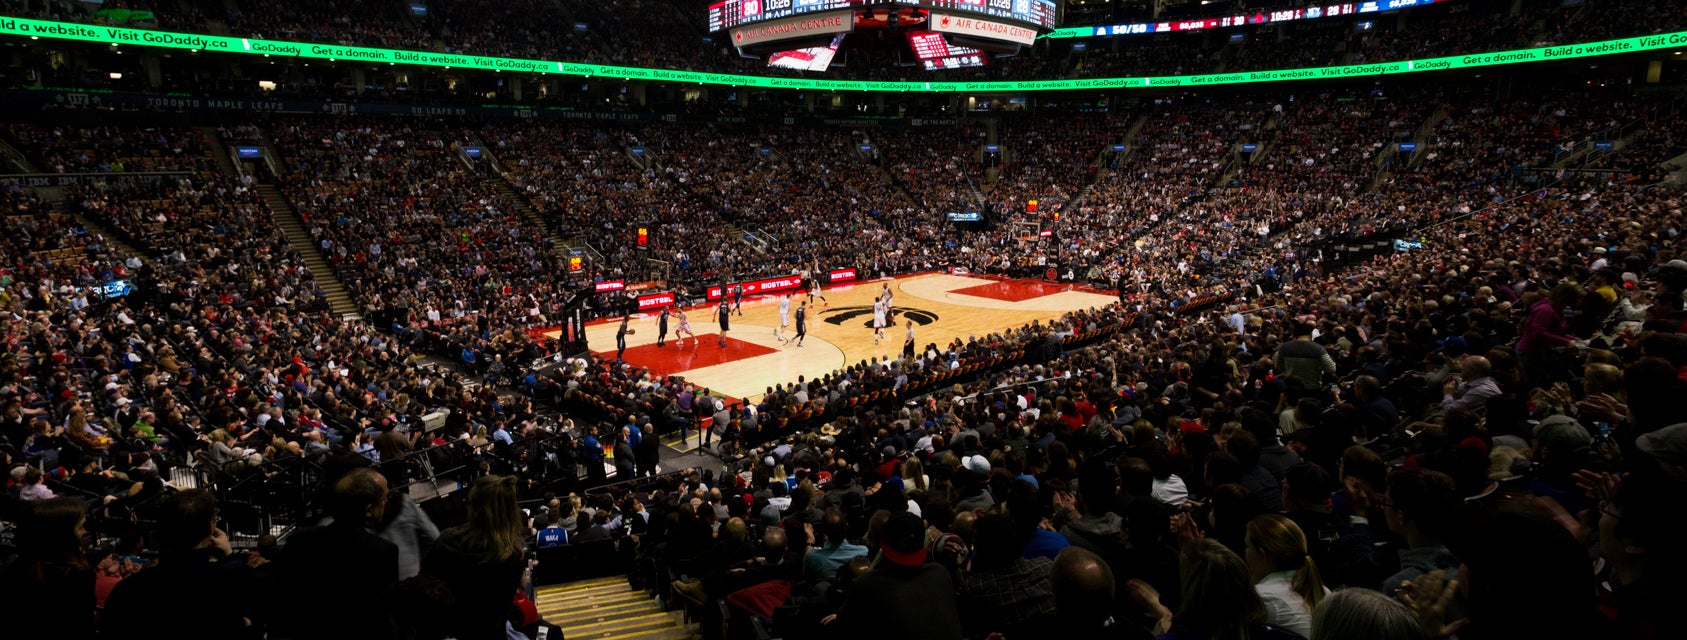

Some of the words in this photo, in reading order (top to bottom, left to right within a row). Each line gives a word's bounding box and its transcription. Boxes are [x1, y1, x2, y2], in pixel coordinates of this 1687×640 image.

[1270, 10, 1294, 22] 10:26
[1327, 6, 1340, 16] 28
[1234, 16, 1244, 26] 30
[746, 30, 758, 39] AIR
[762, 24, 797, 36] CANADA
[801, 17, 841, 30] CENTRE
[956, 18, 972, 30] AIR
[976, 21, 1008, 34] CANADA
[1010, 27, 1034, 40] CENTRE
[1112, 24, 1146, 35] 50/50
[34, 25, 101, 37] website.
[107, 29, 140, 40] Visit
[143, 33, 228, 48] GoDaddy.ca
[252, 43, 301, 54] GoDaddy
[312, 46, 333, 55] Get
[346, 49, 388, 58] domain.
[394, 52, 420, 61] Build
[430, 56, 470, 64] website.
[474, 58, 494, 66] Visit
[496, 60, 548, 70] GoDaddy.ca
[1414, 61, 1452, 69] GoDaddy
[1494, 52, 1536, 61] domain.
[1544, 47, 1572, 56] Build
[1585, 42, 1632, 53] website.
[1640, 37, 1666, 47] Visit
[564, 66, 594, 74] GoDaddy
[1343, 66, 1400, 74] GoDaddy.ca
[148, 98, 200, 108] TORONTO
[208, 100, 244, 110] MAPLE
[251, 102, 284, 110] LEAFS
[28, 177, 48, 186] IBM
[58, 176, 78, 185] IBM
[831, 272, 854, 280] BIOSTEEL
[596, 282, 624, 290] BIOSTEEL
[761, 280, 792, 290] BIOSTEEL
[639, 296, 673, 306] BIOSTEEL
